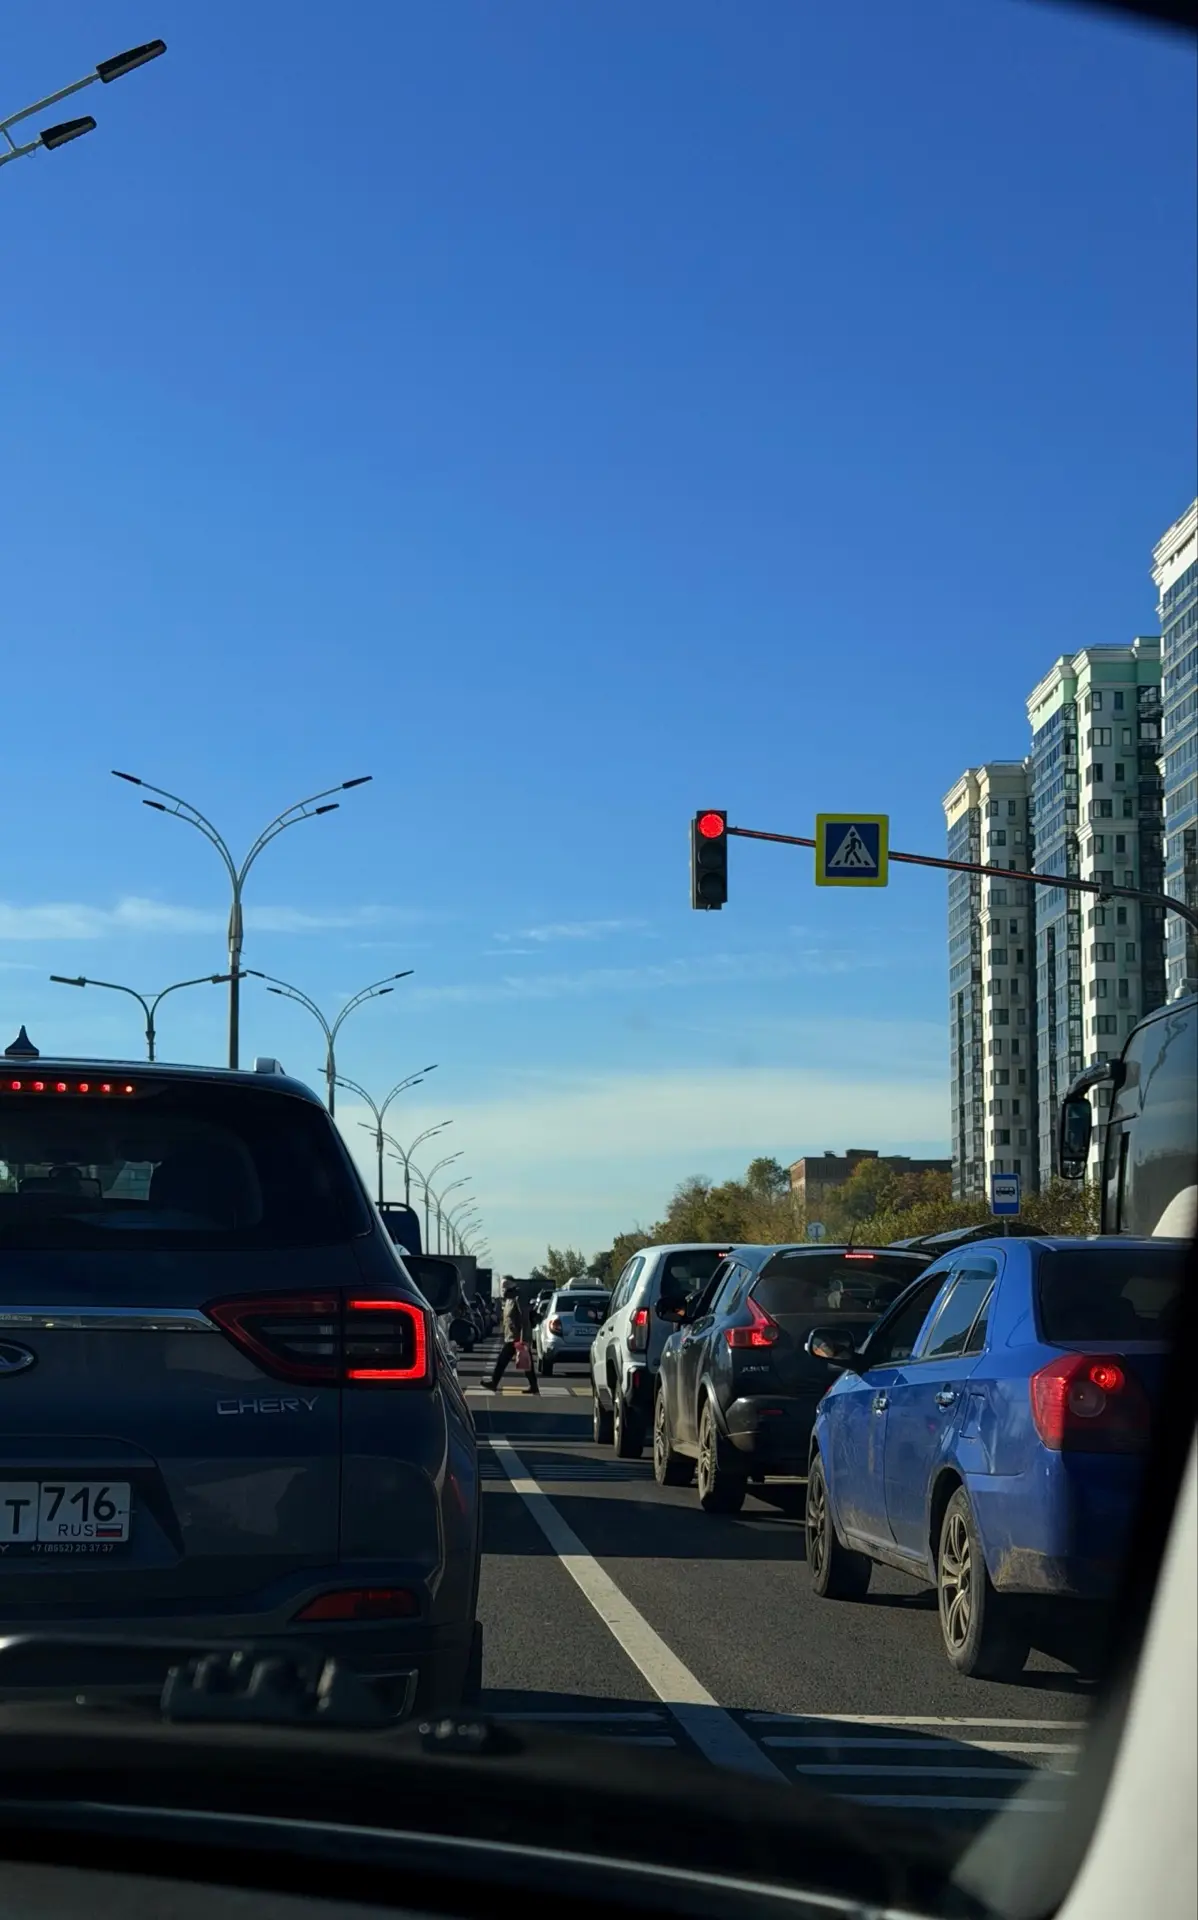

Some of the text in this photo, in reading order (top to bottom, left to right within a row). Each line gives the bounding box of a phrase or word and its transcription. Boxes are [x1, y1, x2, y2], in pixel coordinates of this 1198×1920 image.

[216, 1395, 319, 1414] CHERY
[44, 1486, 117, 1522] 716
[58, 1523, 94, 1537] RUS
